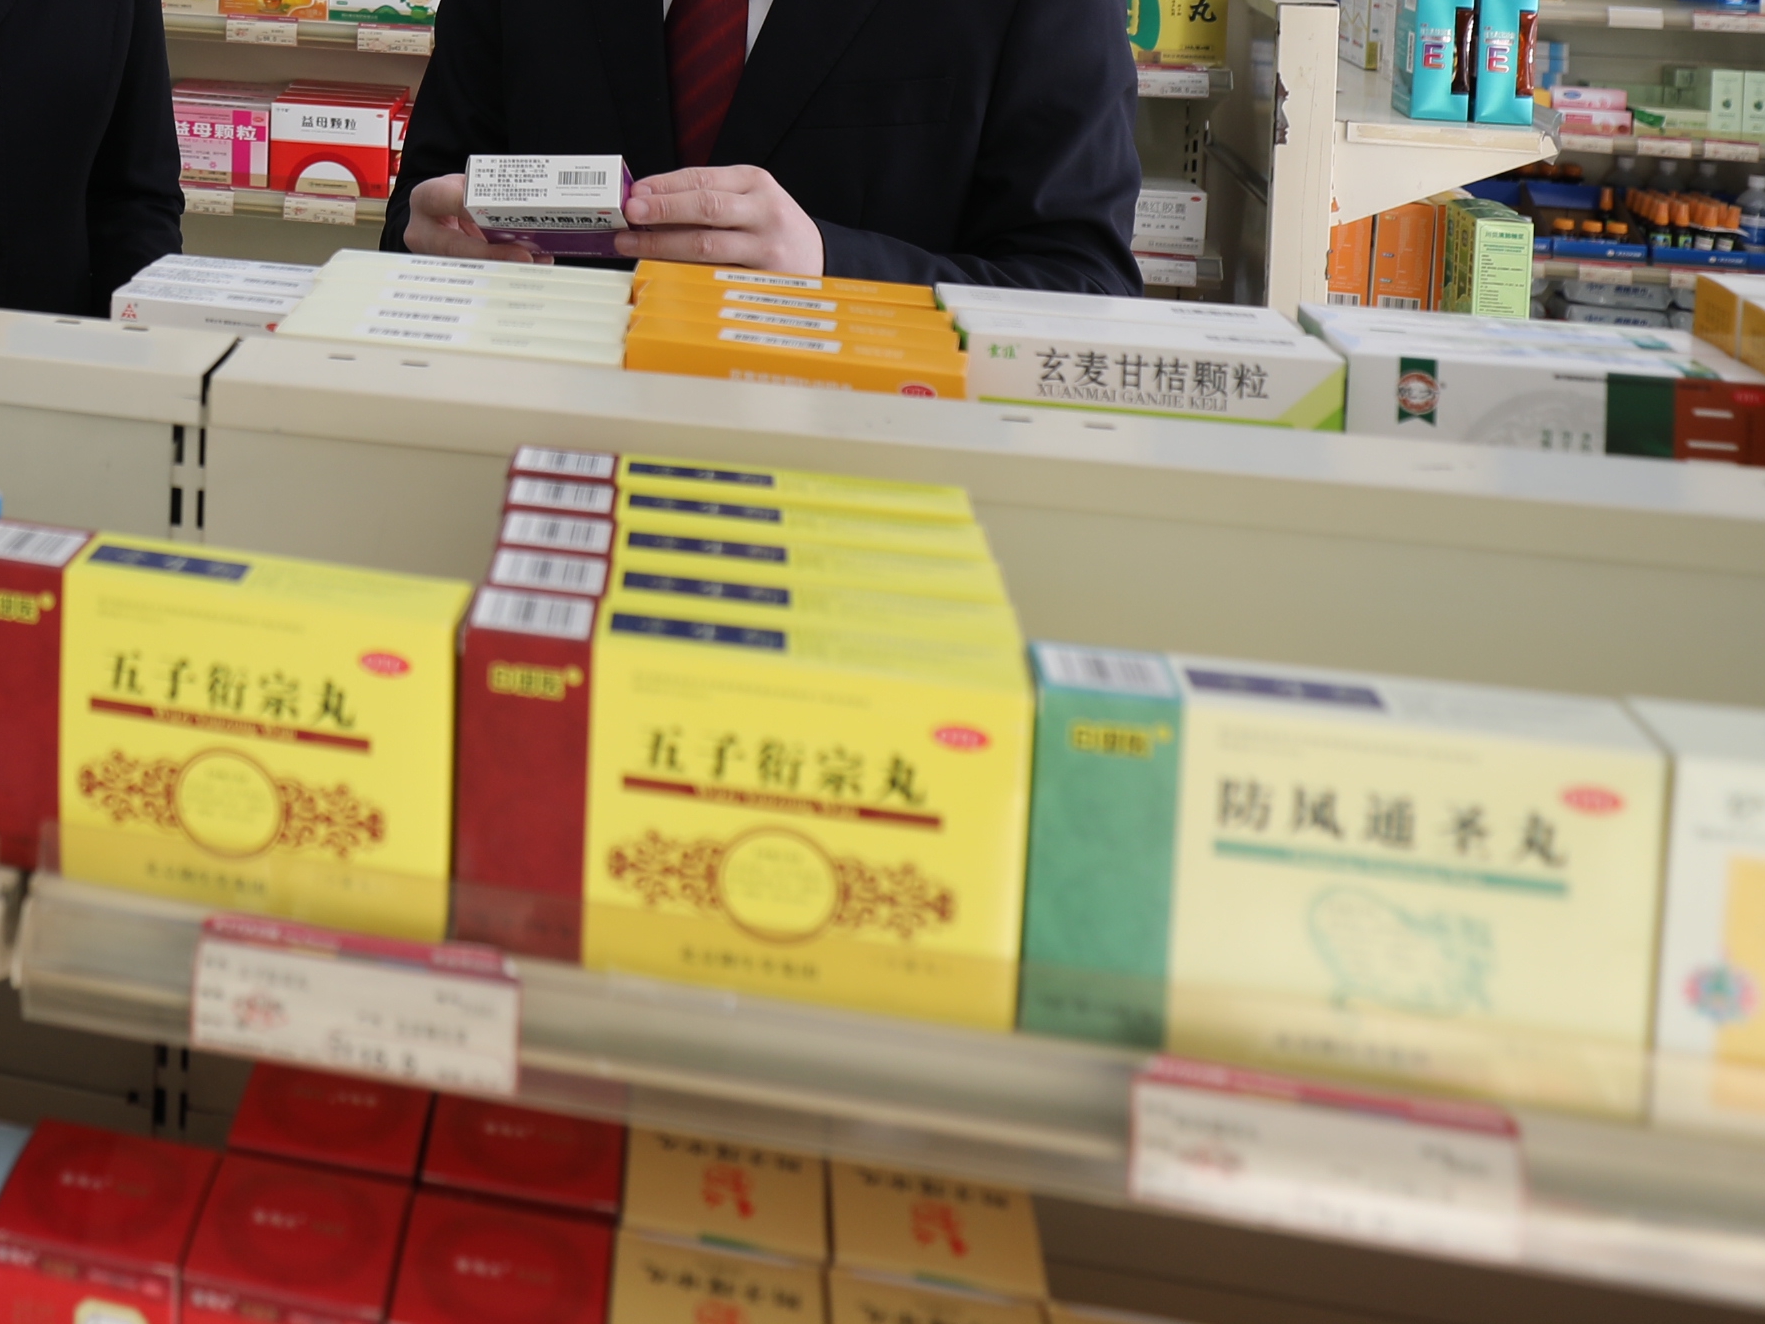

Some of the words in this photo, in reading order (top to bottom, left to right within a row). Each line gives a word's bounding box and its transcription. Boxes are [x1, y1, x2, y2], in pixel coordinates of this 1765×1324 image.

[1423, 42, 1446, 70] E
[1487, 45, 1510, 73] E
[175, 121, 258, 141] 益母颗粒
[301, 115, 357, 131] 益母颗粒
[1036, 348, 1268, 402] 玄麦甘桔颗粒
[1036, 382, 1119, 405] XUANMAI
[1122, 388, 1184, 410] GANJIE
[1187, 393, 1229, 413] KELI
[107, 649, 357, 729] 五子衍宗丸
[644, 724, 928, 806] 五子衍宗丸
[1215, 776, 1568, 870] 防风通圣丸
